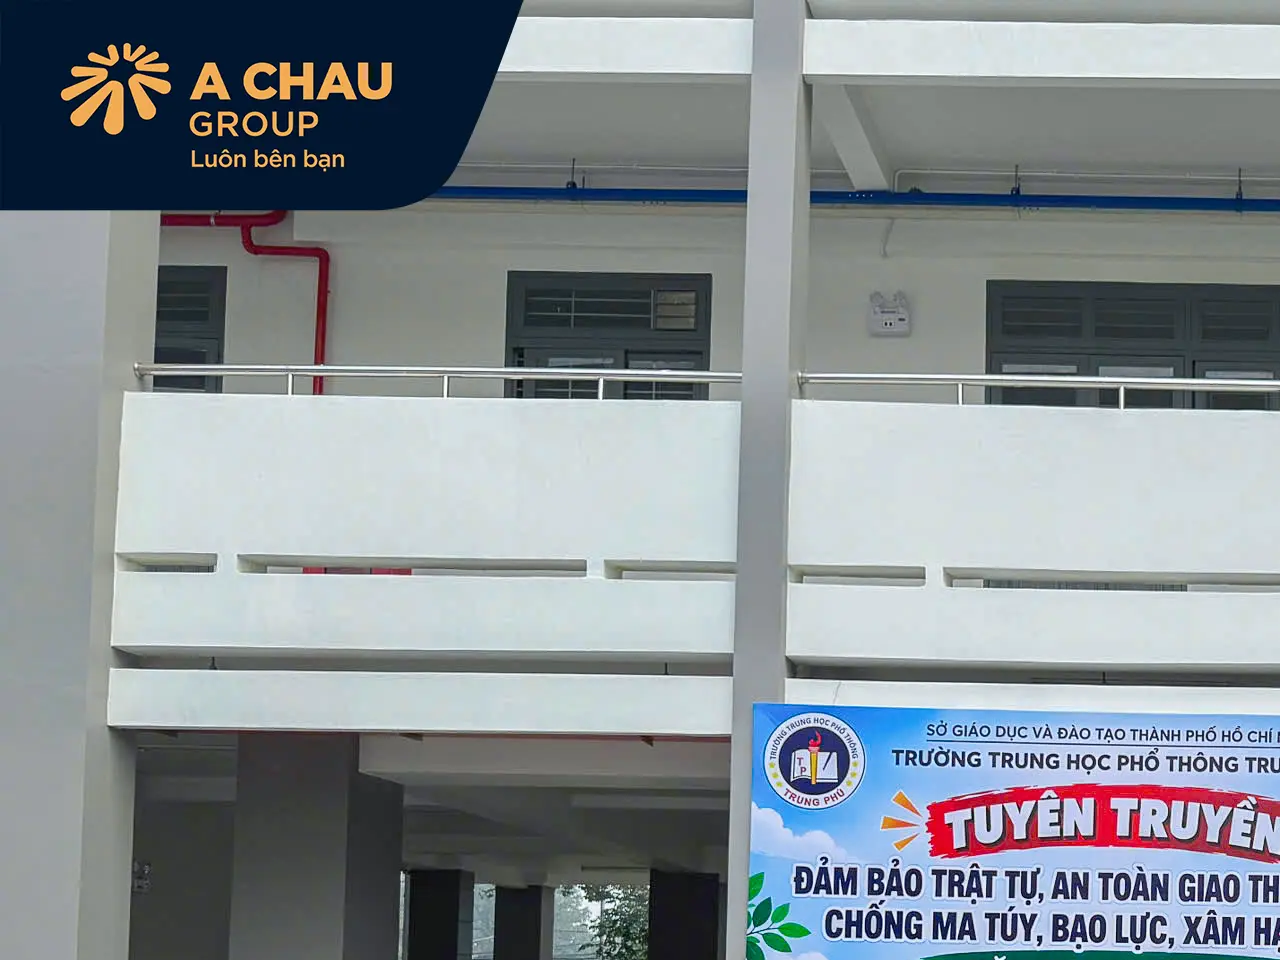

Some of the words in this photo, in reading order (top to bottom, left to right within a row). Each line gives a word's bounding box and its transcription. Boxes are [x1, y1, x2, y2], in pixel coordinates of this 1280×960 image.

[770, 730, 788, 760] TRƯỜNG
[786, 717, 812, 732] TRUNG
[814, 717, 830, 726] HỌC
[830, 722, 848, 734] PHỔ
[844, 734, 858, 759] THÔNG
[926, 720, 948, 736] SỞ
[952, 722, 991, 738] GIÁO
[996, 726, 1028, 741] DỤC
[1032, 724, 1052, 739] VÀ
[1057, 725, 1090, 740] ĐÀO
[1095, 728, 1126, 743] TẠO
[1130, 726, 1180, 742] THÀNH
[1186, 726, 1217, 742] PHỐ
[1221, 726, 1242, 742] HỒ
[1248, 726, 1272, 743] CHÍ
[796, 757, 804, 766] T
[800, 766, 806, 775] P
[892, 746, 982, 768] TRƯỜNG
[988, 752, 1060, 770] TRUNG
[1066, 754, 1111, 775] HỌC
[1117, 748, 1160, 772] PHỔ
[1166, 752, 1239, 773] THÔNG
[784, 788, 820, 806] TRUNG
[824, 788, 845, 804] PHÚ
[944, 790, 1096, 850] TUYÊN
[794, 857, 858, 896] ĐẢM
[867, 859, 923, 897] BẢO
[931, 863, 996, 904] TRẬT
[1004, 868, 1044, 906] TỰ,
[1051, 871, 1090, 900] AN
[1098, 866, 1169, 902] TOÀN
[1178, 873, 1242, 902] GIAO
[824, 900, 923, 940] CHỐNG
[932, 911, 977, 940] MA
[985, 906, 1043, 946] TÚY,
[1052, 914, 1106, 950] BẠO
[1115, 912, 1175, 950] LỰC,
[1182, 910, 1246, 946] XÂM
